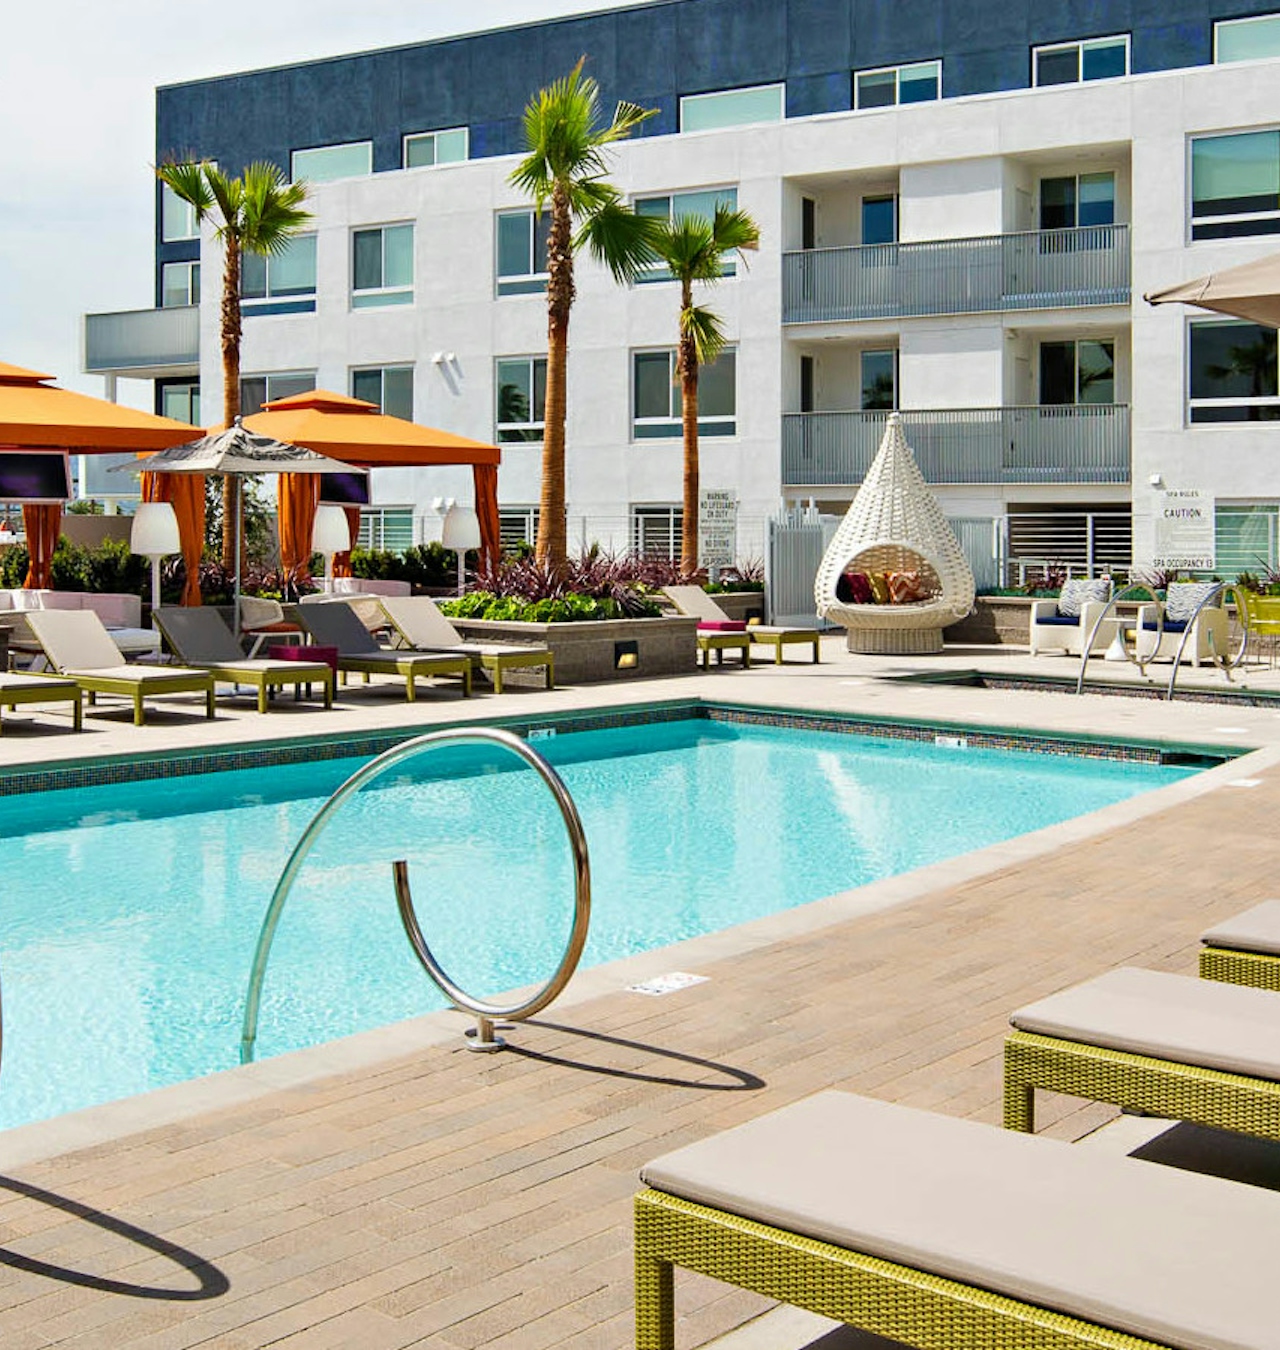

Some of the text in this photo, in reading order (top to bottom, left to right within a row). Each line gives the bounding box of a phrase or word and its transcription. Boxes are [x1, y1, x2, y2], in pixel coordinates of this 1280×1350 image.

[1164, 508, 1202, 518] CAUTION
[1153, 559, 1165, 567] SPA
[1167, 559, 1204, 567] OCCUPANCY
